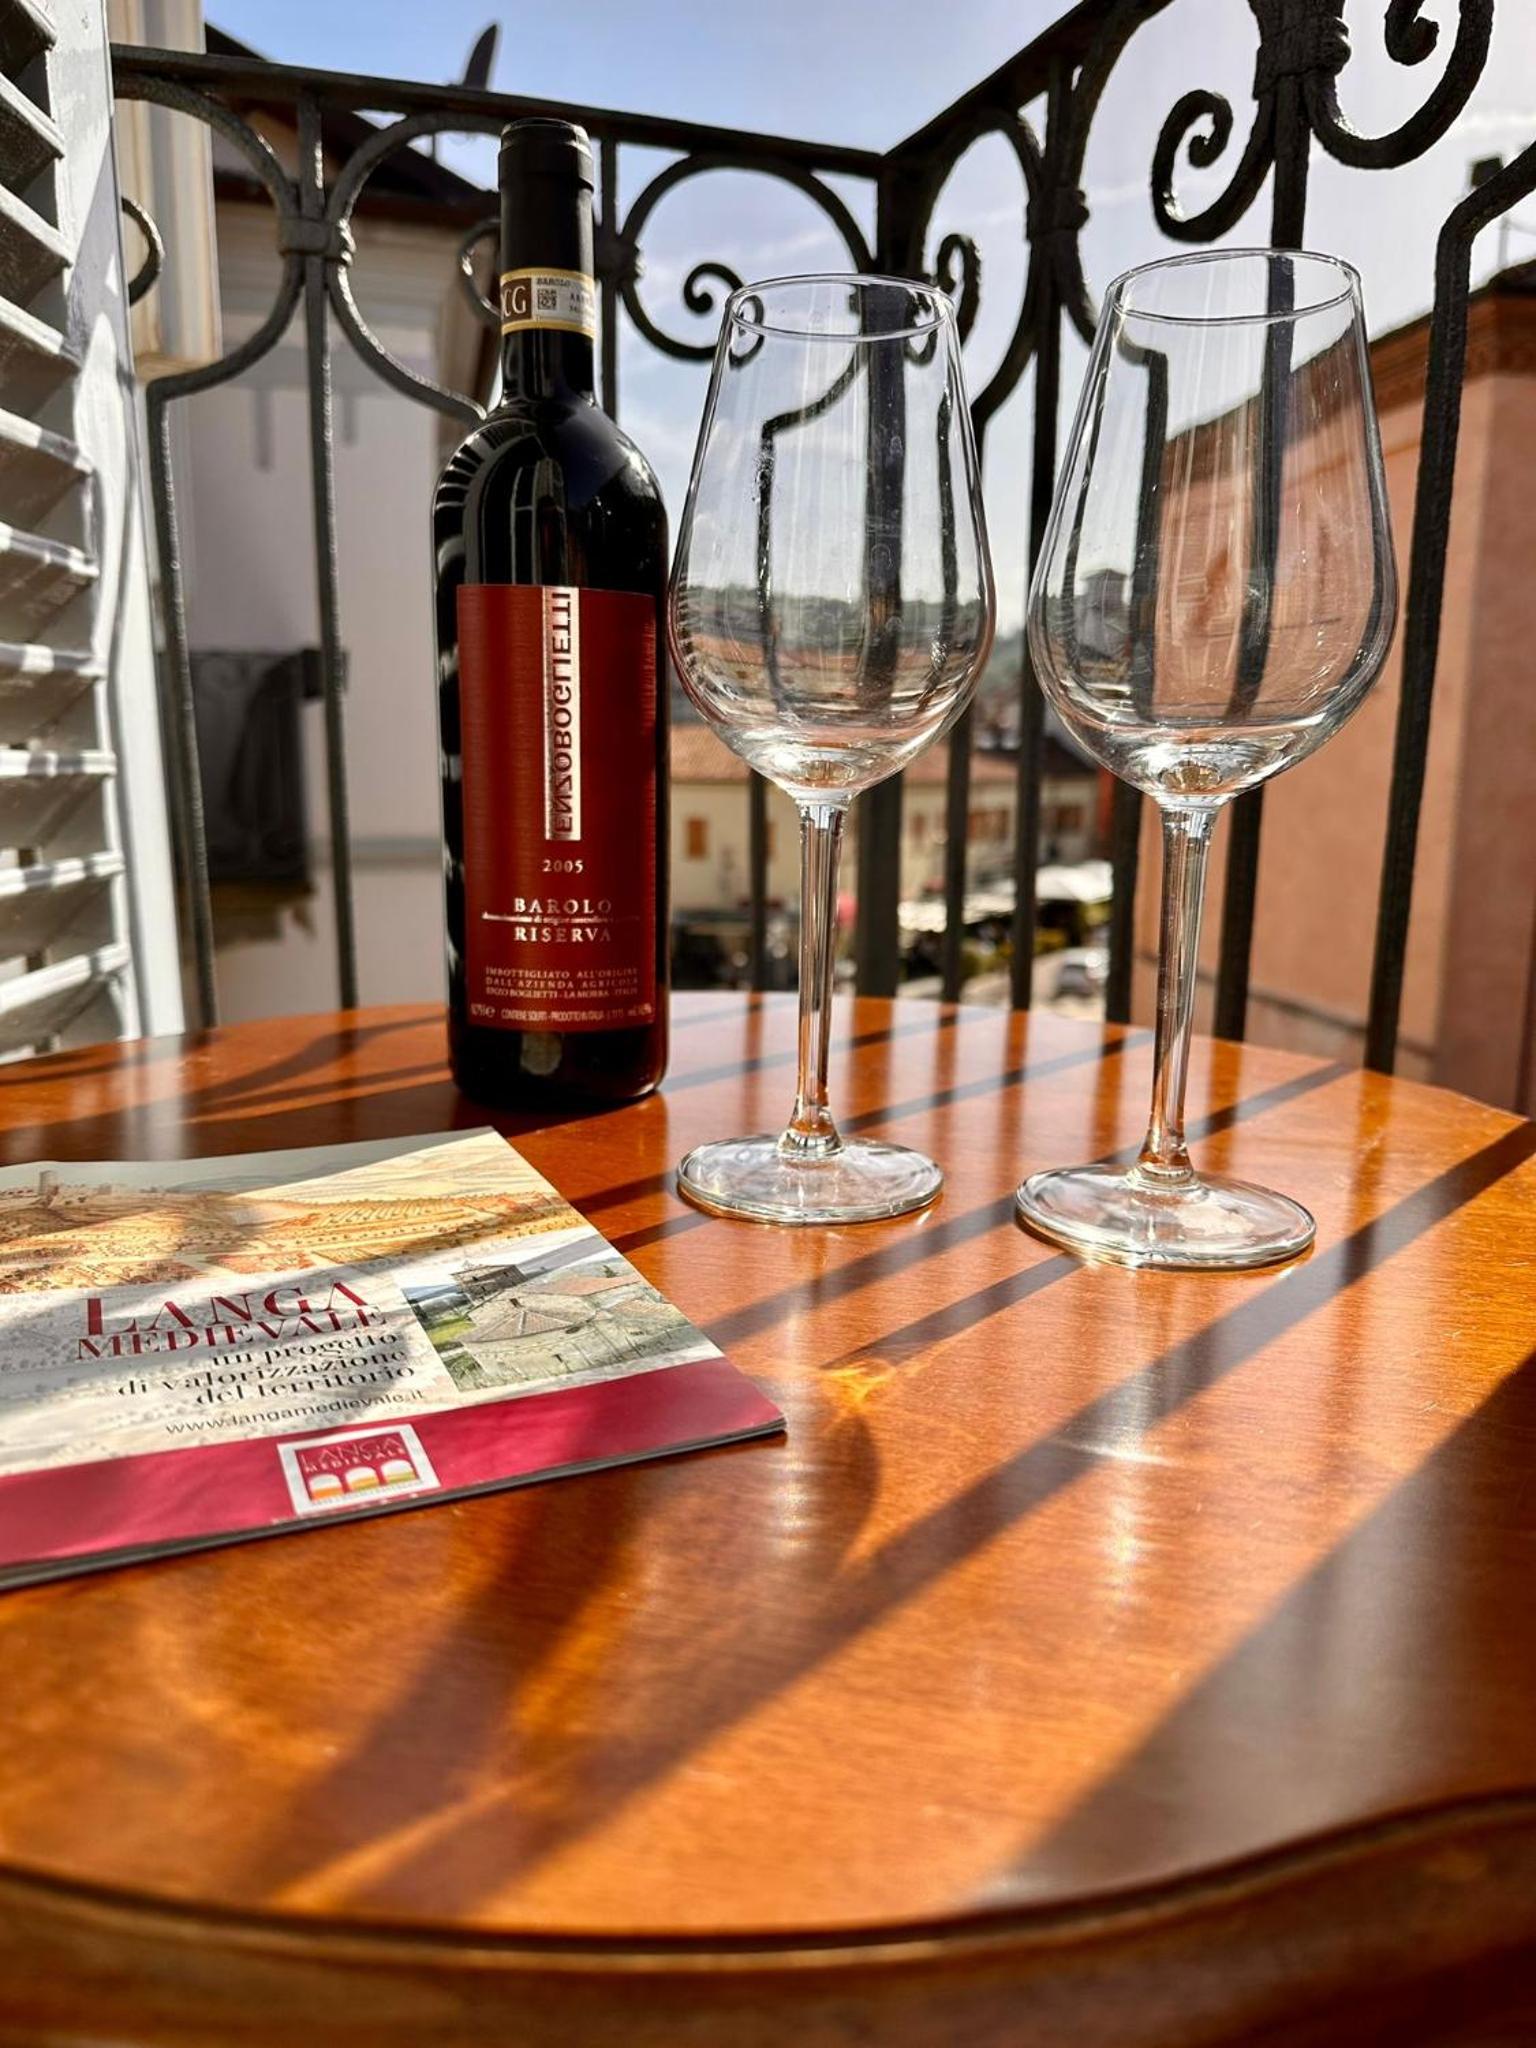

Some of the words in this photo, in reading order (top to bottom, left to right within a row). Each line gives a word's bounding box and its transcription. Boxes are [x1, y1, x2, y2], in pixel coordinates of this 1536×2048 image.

[501, 285, 527, 318] CG
[542, 859, 584, 874] 2005
[514, 898, 612, 915] BAROLO
[514, 926, 612, 943] RISERVA
[85, 1281, 369, 1336] LANGA
[78, 1304, 388, 1361] MEDIEVALE
[212, 1353, 252, 1367] un
[265, 1331, 399, 1366] progetto
[118, 1379, 147, 1397] di
[162, 1349, 408, 1391] valorizzazione
[196, 1385, 245, 1406] del
[257, 1364, 416, 1399] territorio
[165, 1387, 426, 1435] www.langamedievale.it
[301, 1437, 401, 1469] LANGA
[304, 1448, 406, 1473] MEDIEVALE
